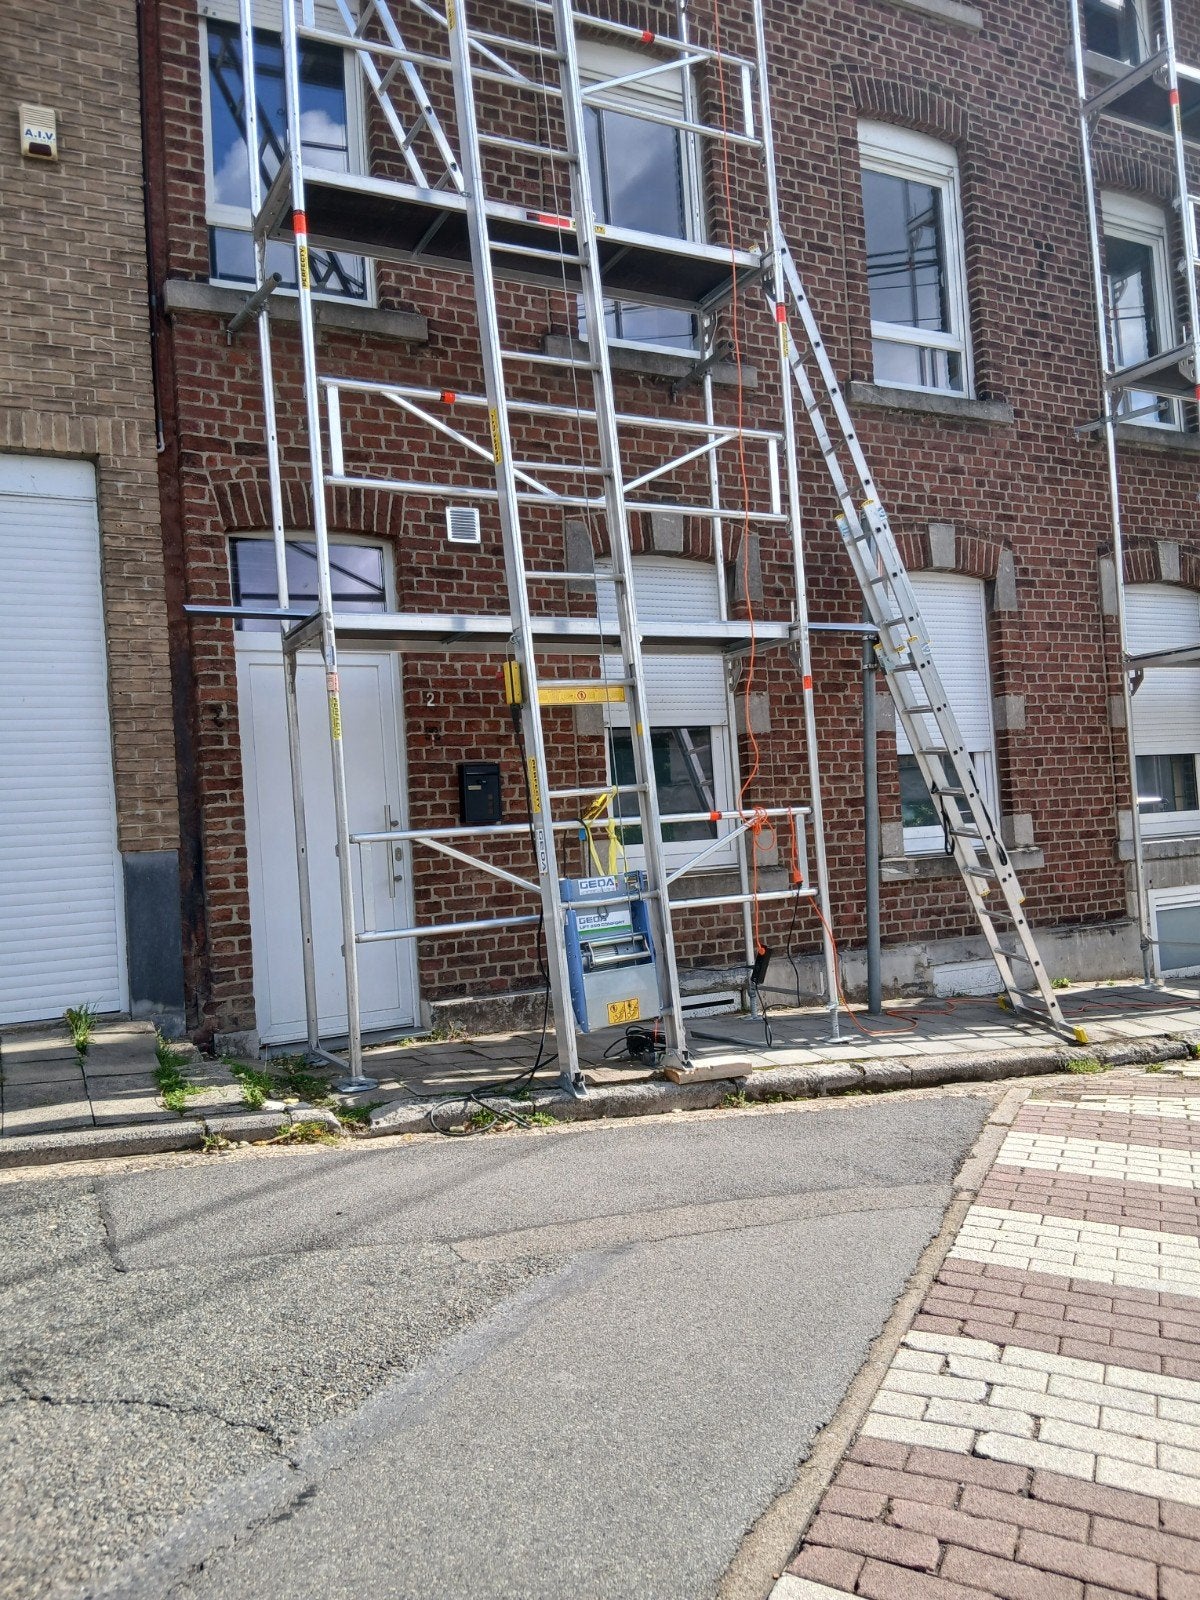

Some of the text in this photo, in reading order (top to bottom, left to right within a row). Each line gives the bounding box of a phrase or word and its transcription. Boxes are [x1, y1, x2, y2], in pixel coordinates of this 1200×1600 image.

[25, 128, 56, 141] A.I.V.
[299, 247, 308, 287] PERFECTY
[426, 692, 435, 707] 2
[538, 830, 548, 871] GEDA
[580, 878, 614, 889] GEDA
